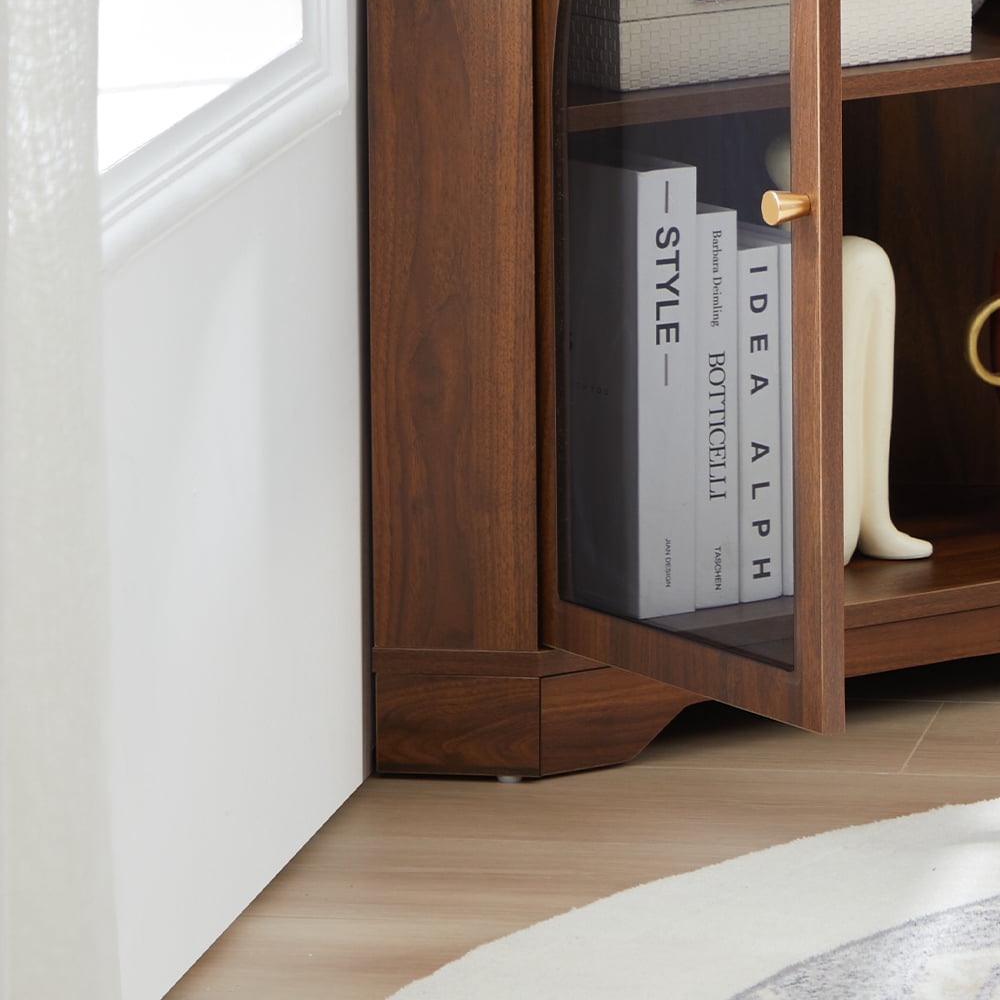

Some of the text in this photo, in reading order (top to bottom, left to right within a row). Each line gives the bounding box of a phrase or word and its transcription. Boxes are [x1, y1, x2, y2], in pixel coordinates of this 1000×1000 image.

[655, 226, 680, 346] STYLE
[710, 230, 723, 328] Barbara Deimling
[708, 351, 727, 501] BOTTICELLI
[749, 265, 771, 580] IDEA ALPH
[664, 557, 672, 588] DESIGN
[714, 546, 722, 591] TASCHEN
